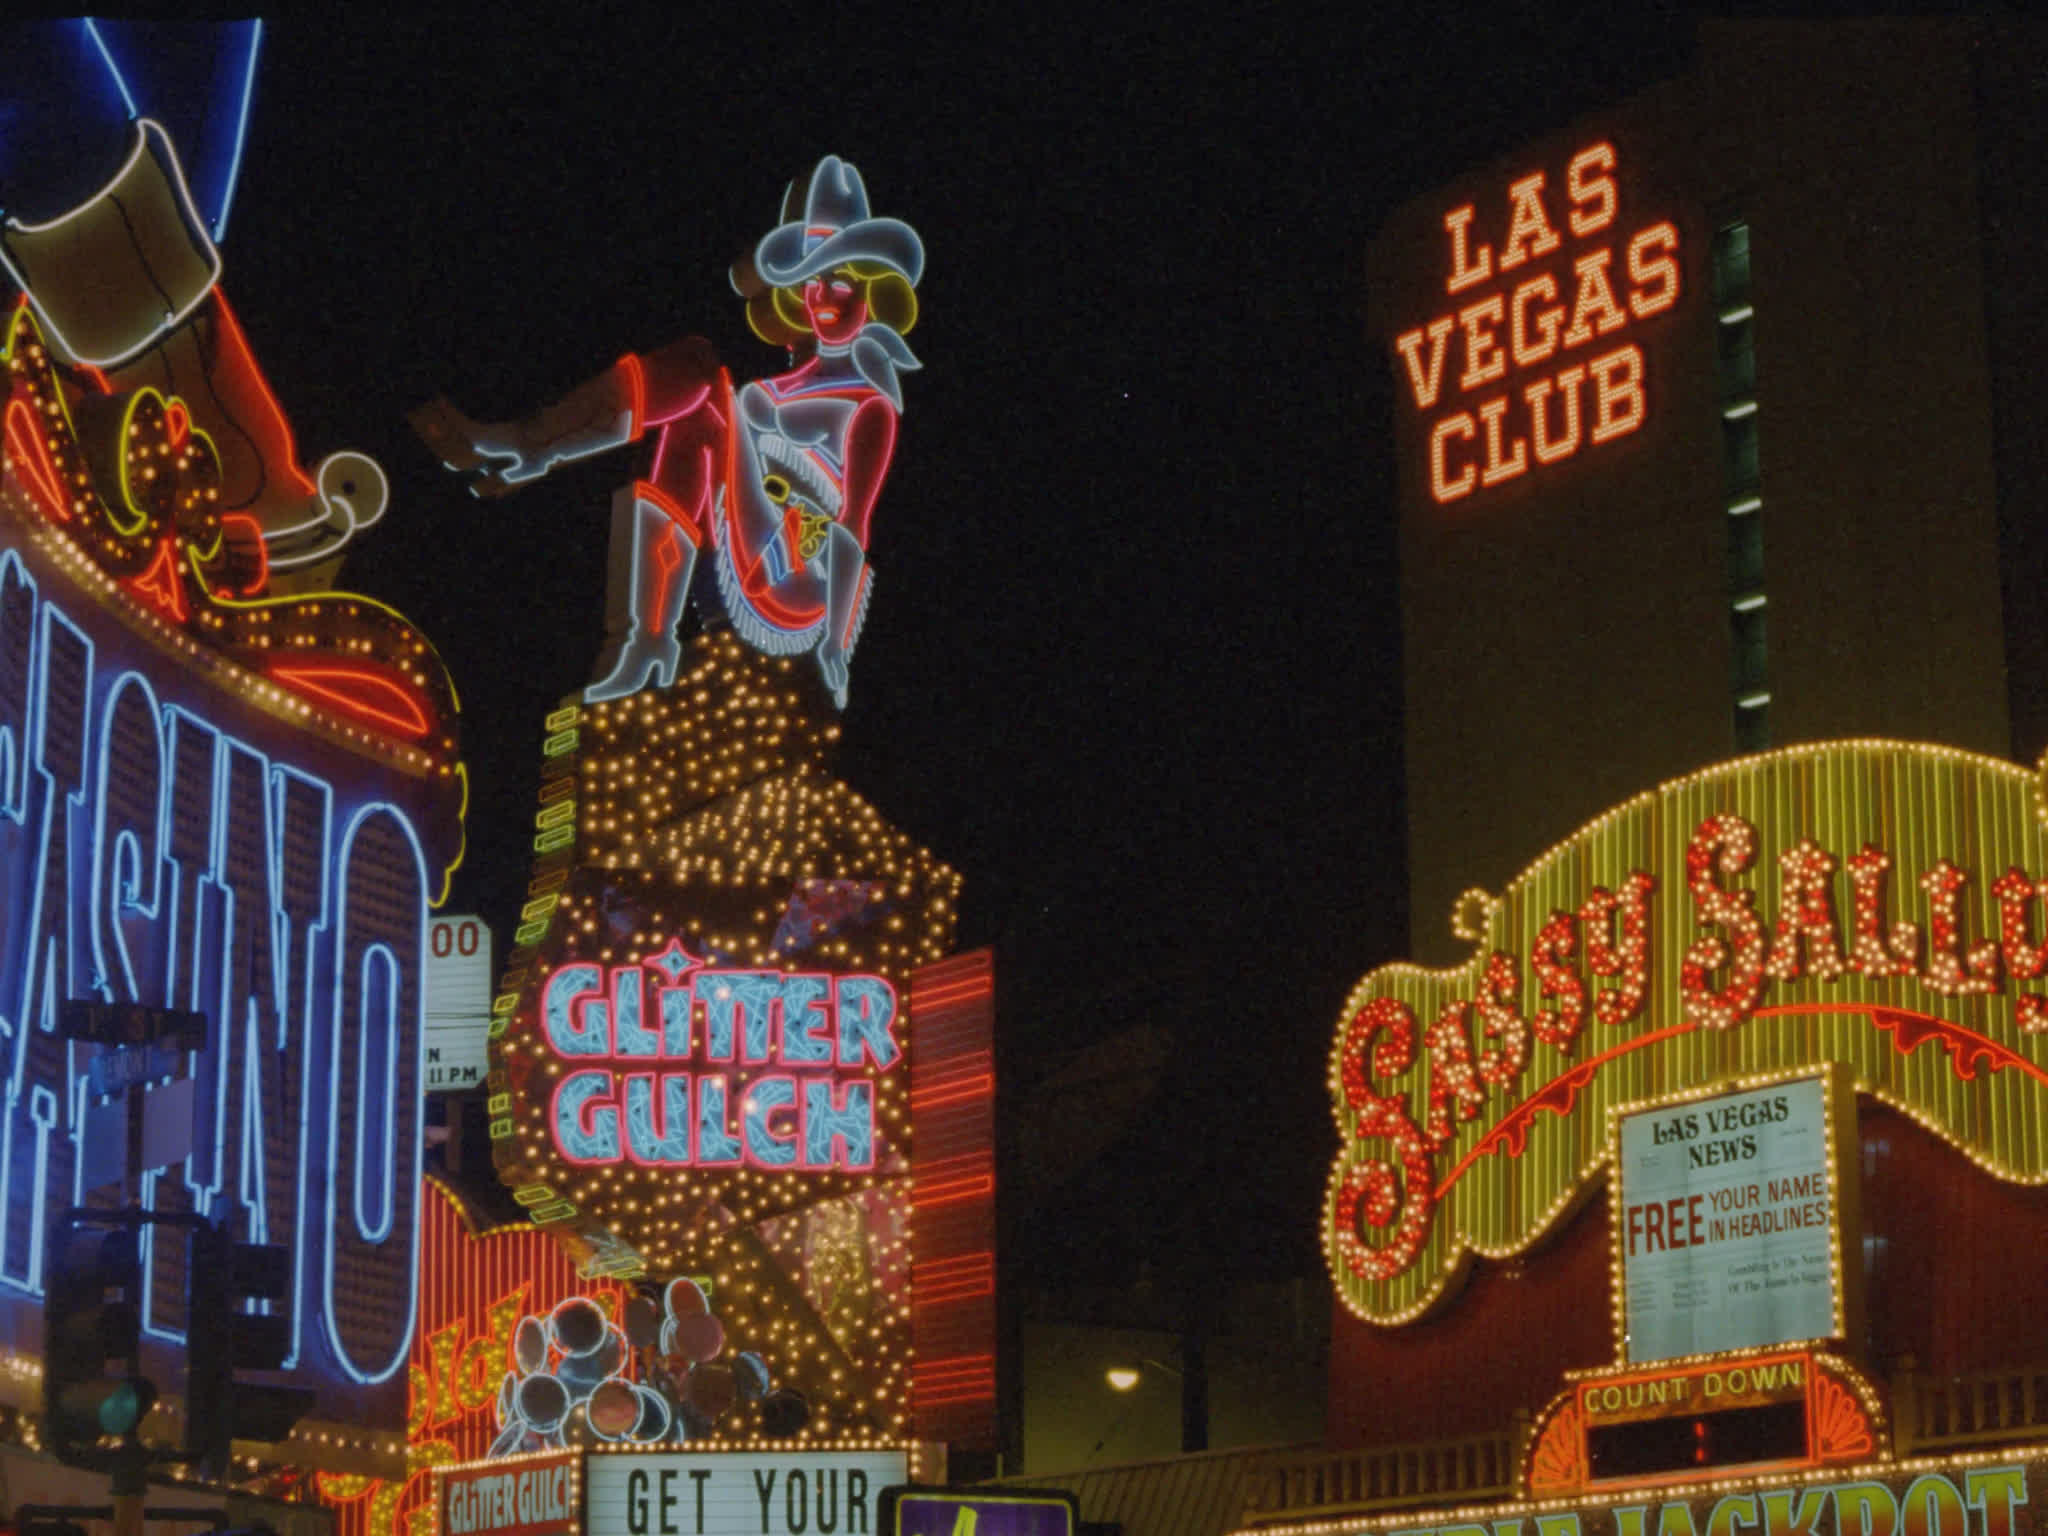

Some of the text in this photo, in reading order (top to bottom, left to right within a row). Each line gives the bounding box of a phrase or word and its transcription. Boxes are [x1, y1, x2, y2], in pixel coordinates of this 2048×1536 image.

[1444, 142, 1617, 294] LAS
[1396, 221, 1680, 409] VEGAS
[1430, 345, 1645, 503] CLUB
[449, 1065, 478, 1082] PM
[1335, 870, 1658, 1282] SASSY
[550, 1069, 877, 1173] GULCH
[1652, 1095, 1790, 1146] LAS VEGAS
[1688, 1134, 1758, 1170] NEWS
[1708, 1201, 1827, 1244] IN HEADLINES
[1709, 1172, 1825, 1213] YOUR NAME
[1627, 1194, 1705, 1257] FREE
[1584, 1362, 1802, 1414] COUNT DOWN
[627, 1468, 868, 1535] GET YOUR
